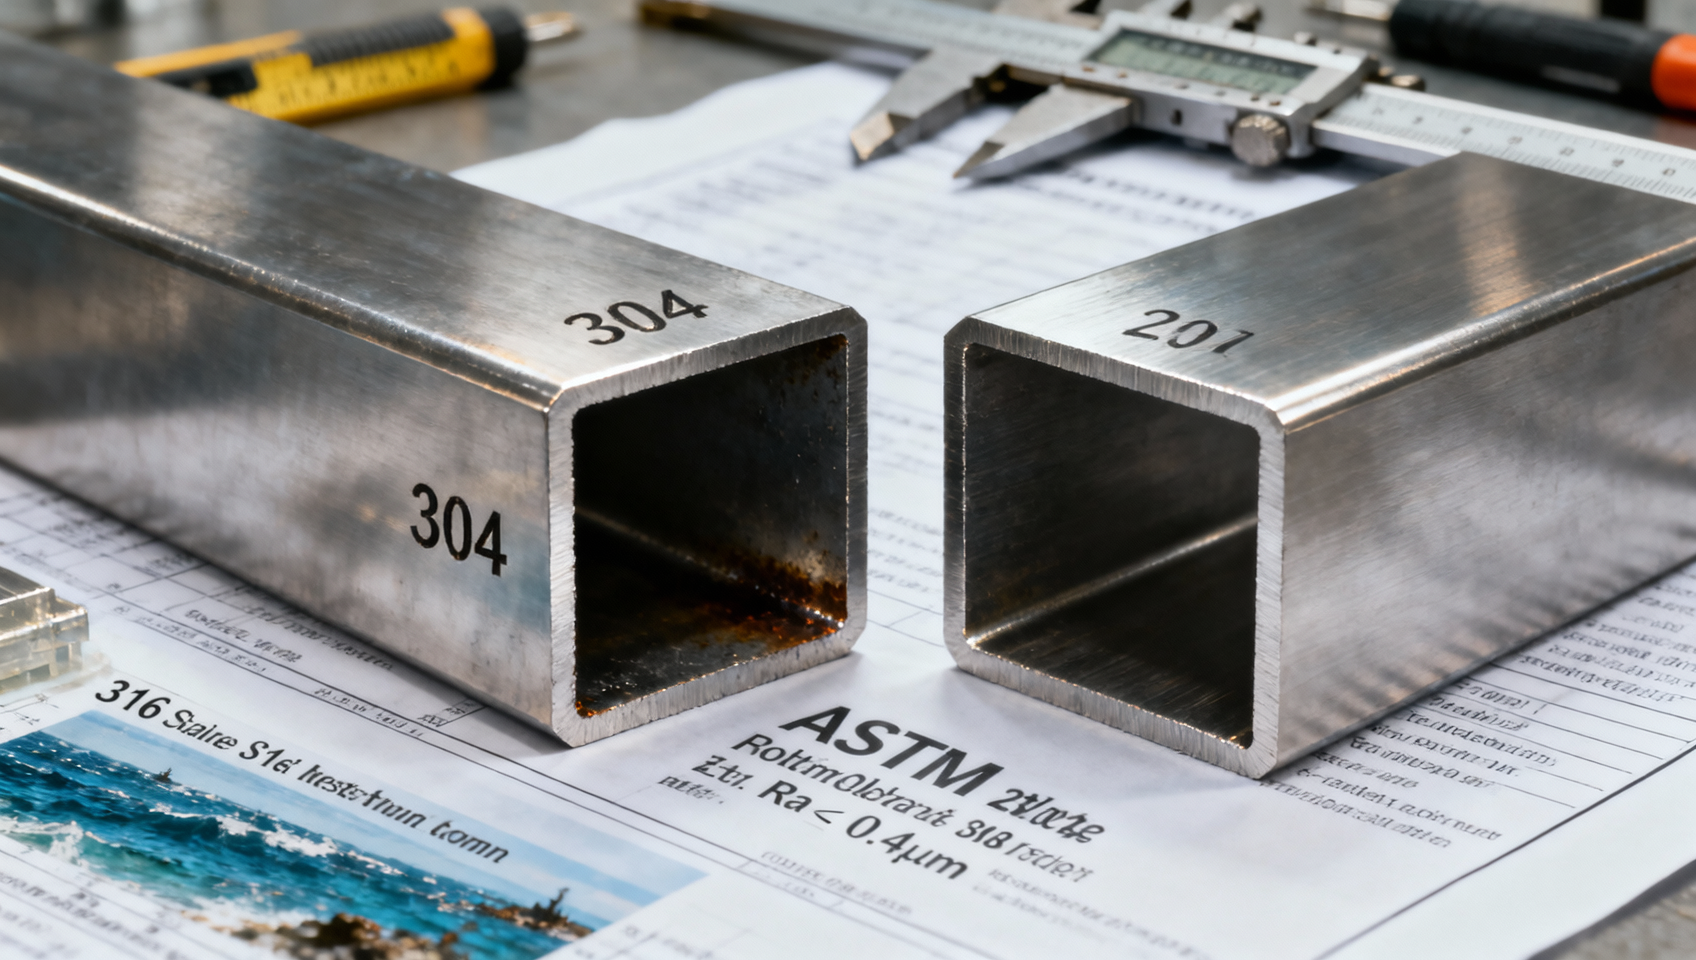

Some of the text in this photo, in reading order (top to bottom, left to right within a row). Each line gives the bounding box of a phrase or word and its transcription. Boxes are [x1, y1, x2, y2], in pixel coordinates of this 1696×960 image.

[564, 289, 709, 346] 304
[1122, 309, 1254, 354] 201
[410, 482, 508, 577] 304
[95, 679, 171, 719] 316
[778, 706, 1004, 797] ASTM
[757, 780, 813, 813] Ra
